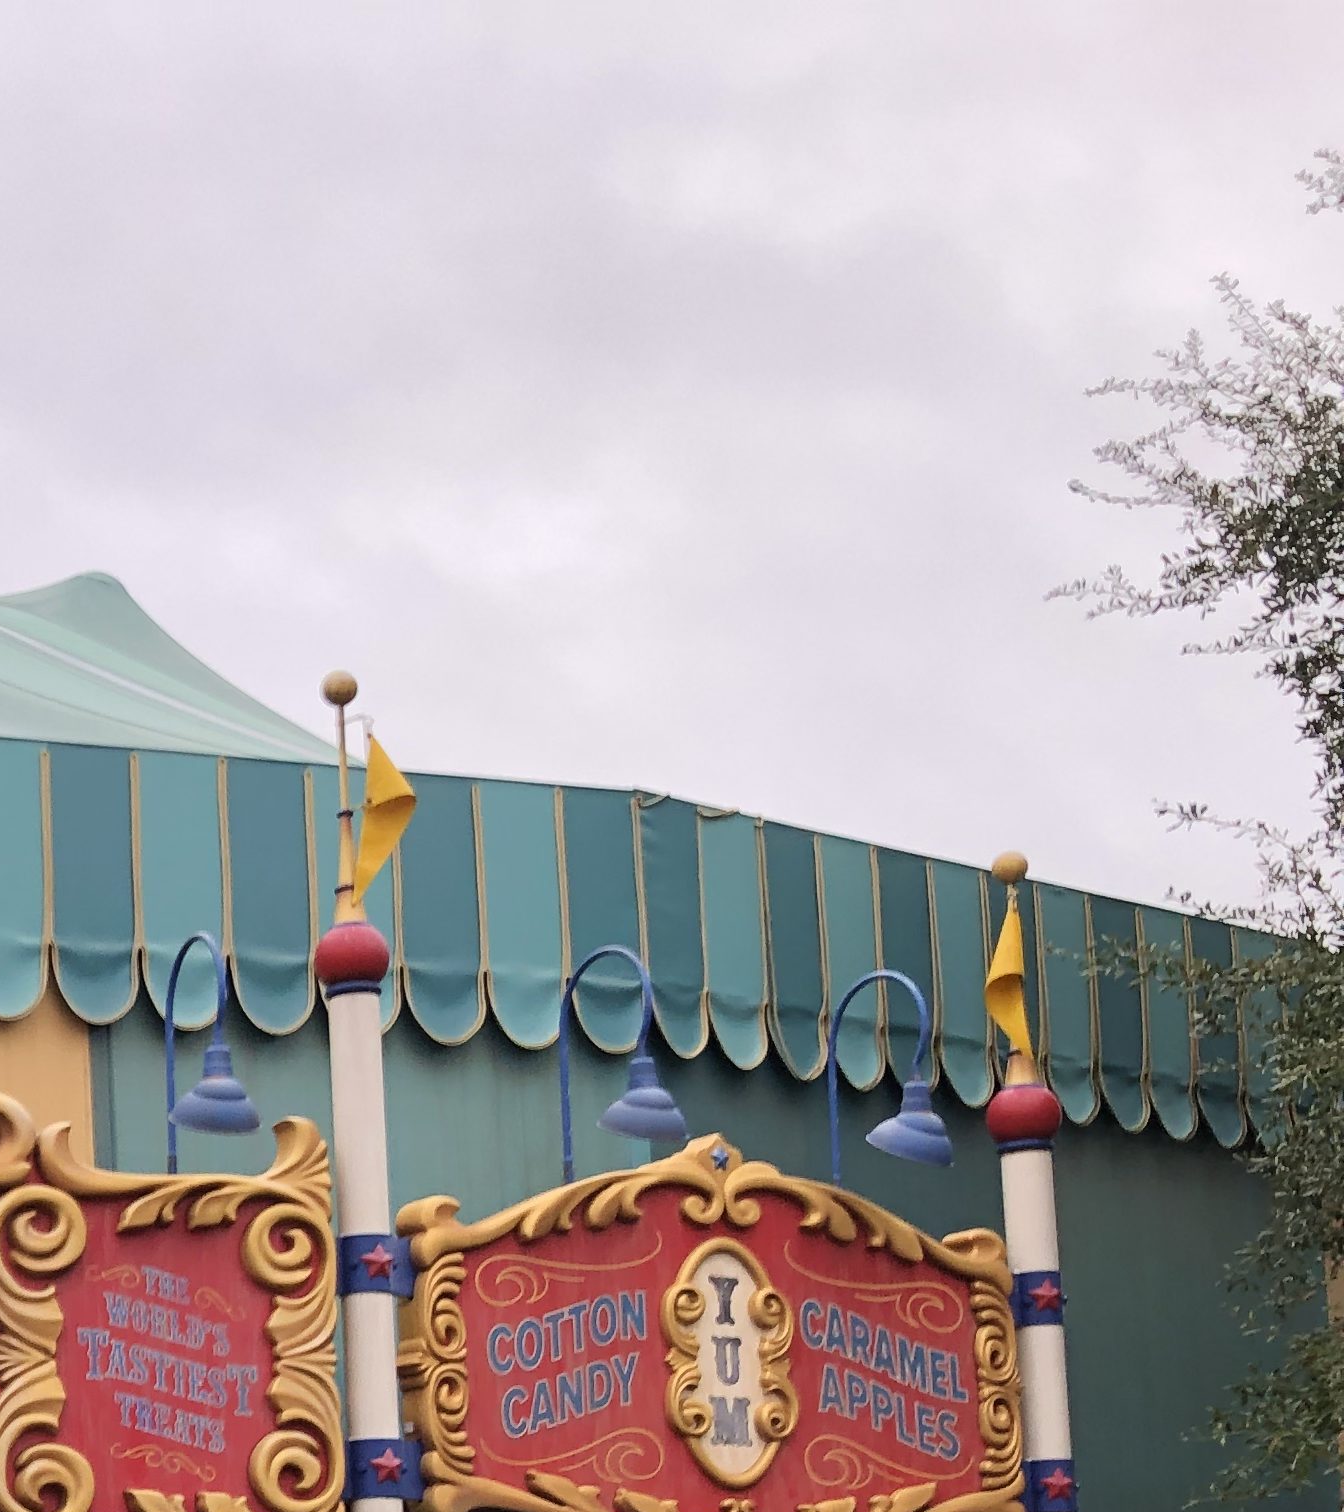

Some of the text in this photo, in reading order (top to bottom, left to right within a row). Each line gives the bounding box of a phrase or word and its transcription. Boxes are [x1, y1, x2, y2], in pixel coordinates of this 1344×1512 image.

[103, 1292, 229, 1356] WORLD'S
[141, 1265, 190, 1304] THE
[77, 1327, 257, 1417] TASTIEST
[486, 1289, 646, 1375] COTTON
[800, 1300, 969, 1403] CARAMEL
[114, 1392, 224, 1453] TREATS
[501, 1352, 640, 1439] CANDY
[818, 1364, 961, 1461] APPLES
